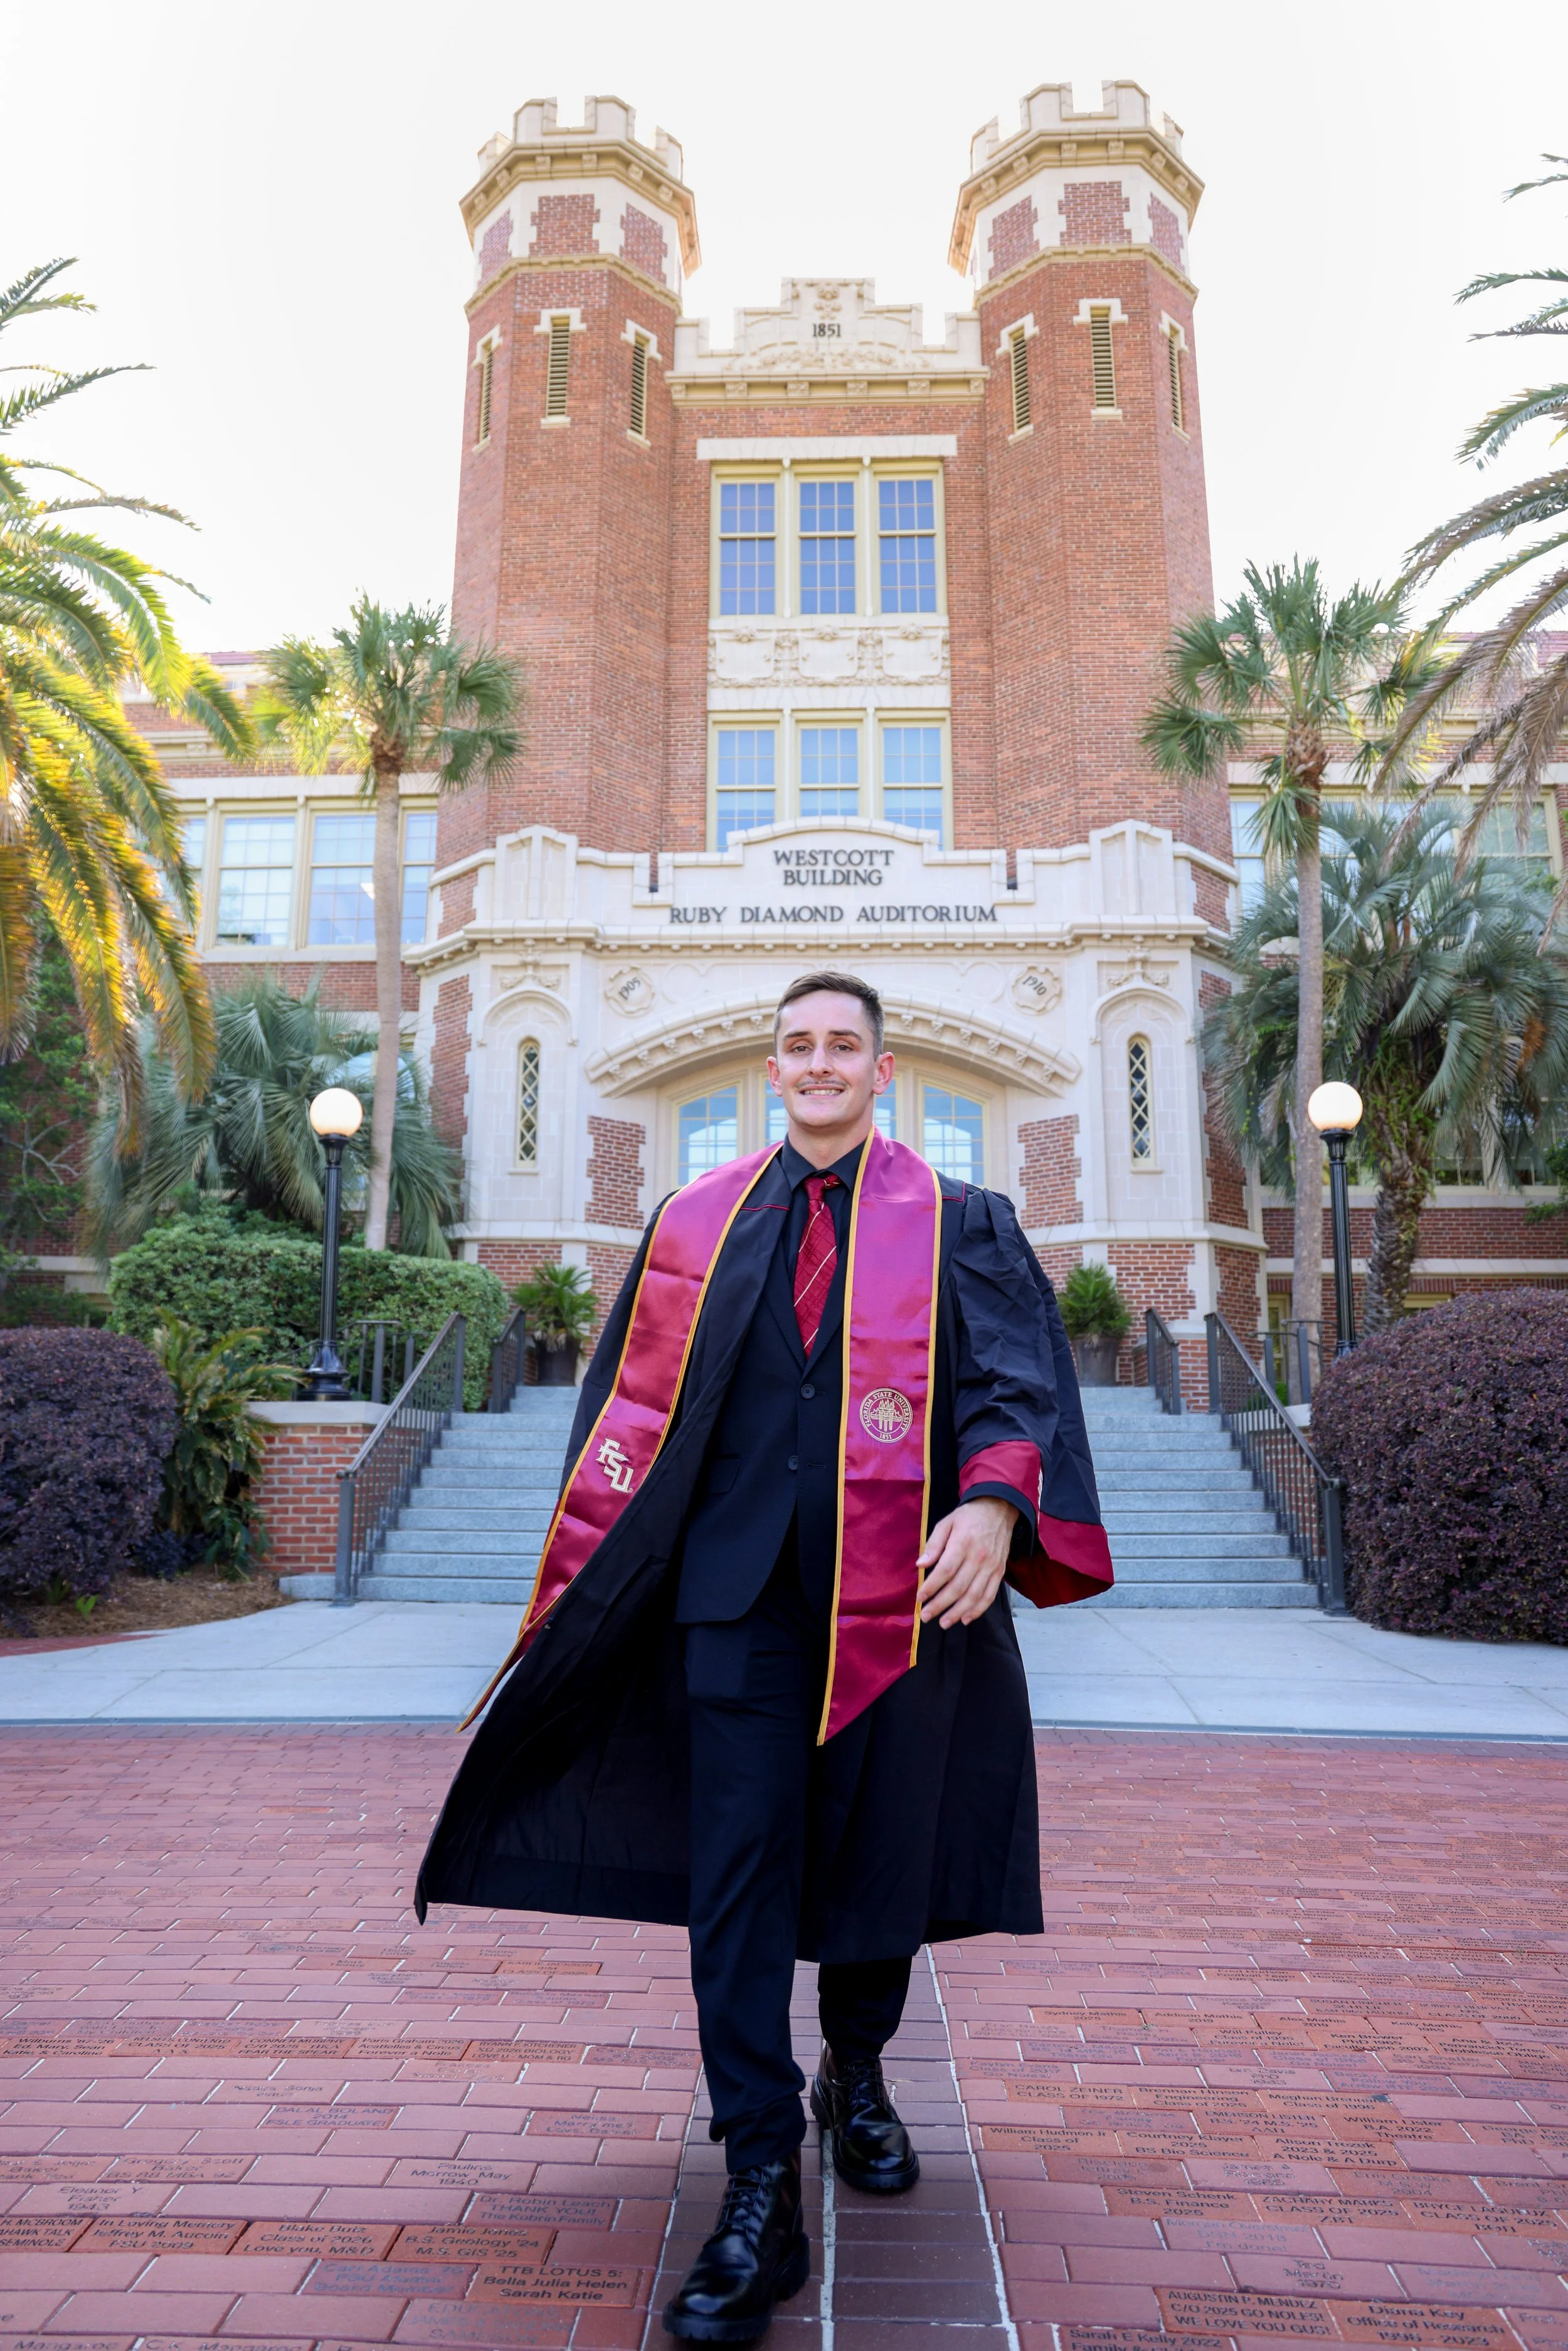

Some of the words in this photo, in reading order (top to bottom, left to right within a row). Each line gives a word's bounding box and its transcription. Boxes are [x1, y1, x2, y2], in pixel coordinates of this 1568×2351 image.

[813, 322, 840, 337] 1851
[773, 850, 894, 866] WESTCOTT
[783, 869, 883, 886] BUILDING
[670, 907, 728, 923] RUBY
[741, 906, 844, 922] DIAMOND
[857, 905, 997, 921] AUDITORIUM
[618, 977, 640, 1000] 1905
[1022, 975, 1047, 995] 1910
[863, 1398, 873, 1428] FLORIDA
[872, 1391, 892, 1399] STATE
[894, 1394, 909, 1431] UNIVERSITY
[595, 1438, 633, 1493] FSU
[1326, 2140, 1375, 2148] Trezek
[1289, 2153, 1323, 2162] Nole
[561, 2199, 610, 2207] Leach
[1263, 2196, 1333, 2204] ZACHARY
[490, 2204, 548, 2212] THANK
[556, 2206, 596, 2215] YOU!
[1266, 2205, 1324, 2214] CLASS
[172, 2221, 235, 2229] Memory
[558, 2216, 605, 2225] Family
[243, 2244, 284, 2252] Love
[442, 2237, 511, 2248] Geology
[457, 2248, 487, 2256] GIS
[501, 2266, 533, 2274] TTB
[539, 2267, 601, 2276] LOTUS
[484, 2277, 526, 2286] Bella
[531, 2279, 569, 2287] Julia
[576, 2279, 627, 2289] Helen
[500, 2288, 551, 2298] Sarah
[558, 2290, 603, 2300] Katie
[1168, 2291, 1239, 2303] AUGUSTIN
[1244, 2296, 1256, 2305] P.
[1259, 2298, 1318, 2309] MENDEZ
[1171, 2303, 1199, 2313] C/O
[1204, 2305, 1239, 2315] 2025
[1241, 2308, 1266, 2318] GO
[1268, 2310, 1325, 2322] NOLES!
[1369, 2305, 1425, 2316] Diana
[1430, 2309, 1465, 2320] Key
[1174, 2315, 1199, 2325] WE
[1205, 2317, 1248, 2329] LOVE
[1252, 2320, 1286, 2332] YOU
[1291, 2324, 1331, 2335] GUS!
[1347, 2316, 1398, 2328] Office
[1403, 2320, 1418, 2328] of
[1422, 2320, 1506, 2335] Research
[1070, 2329, 1117, 2340] Sarah
[1122, 2332, 1133, 2341] E
[1138, 2333, 1176, 2345] Kelly
[1181, 2337, 1222, 2347] 2022
[1377, 2331, 1422, 2342] 1996
[1441, 2335, 1490, 2345] 2023
[1071, 2342, 1126, 2351] Family
